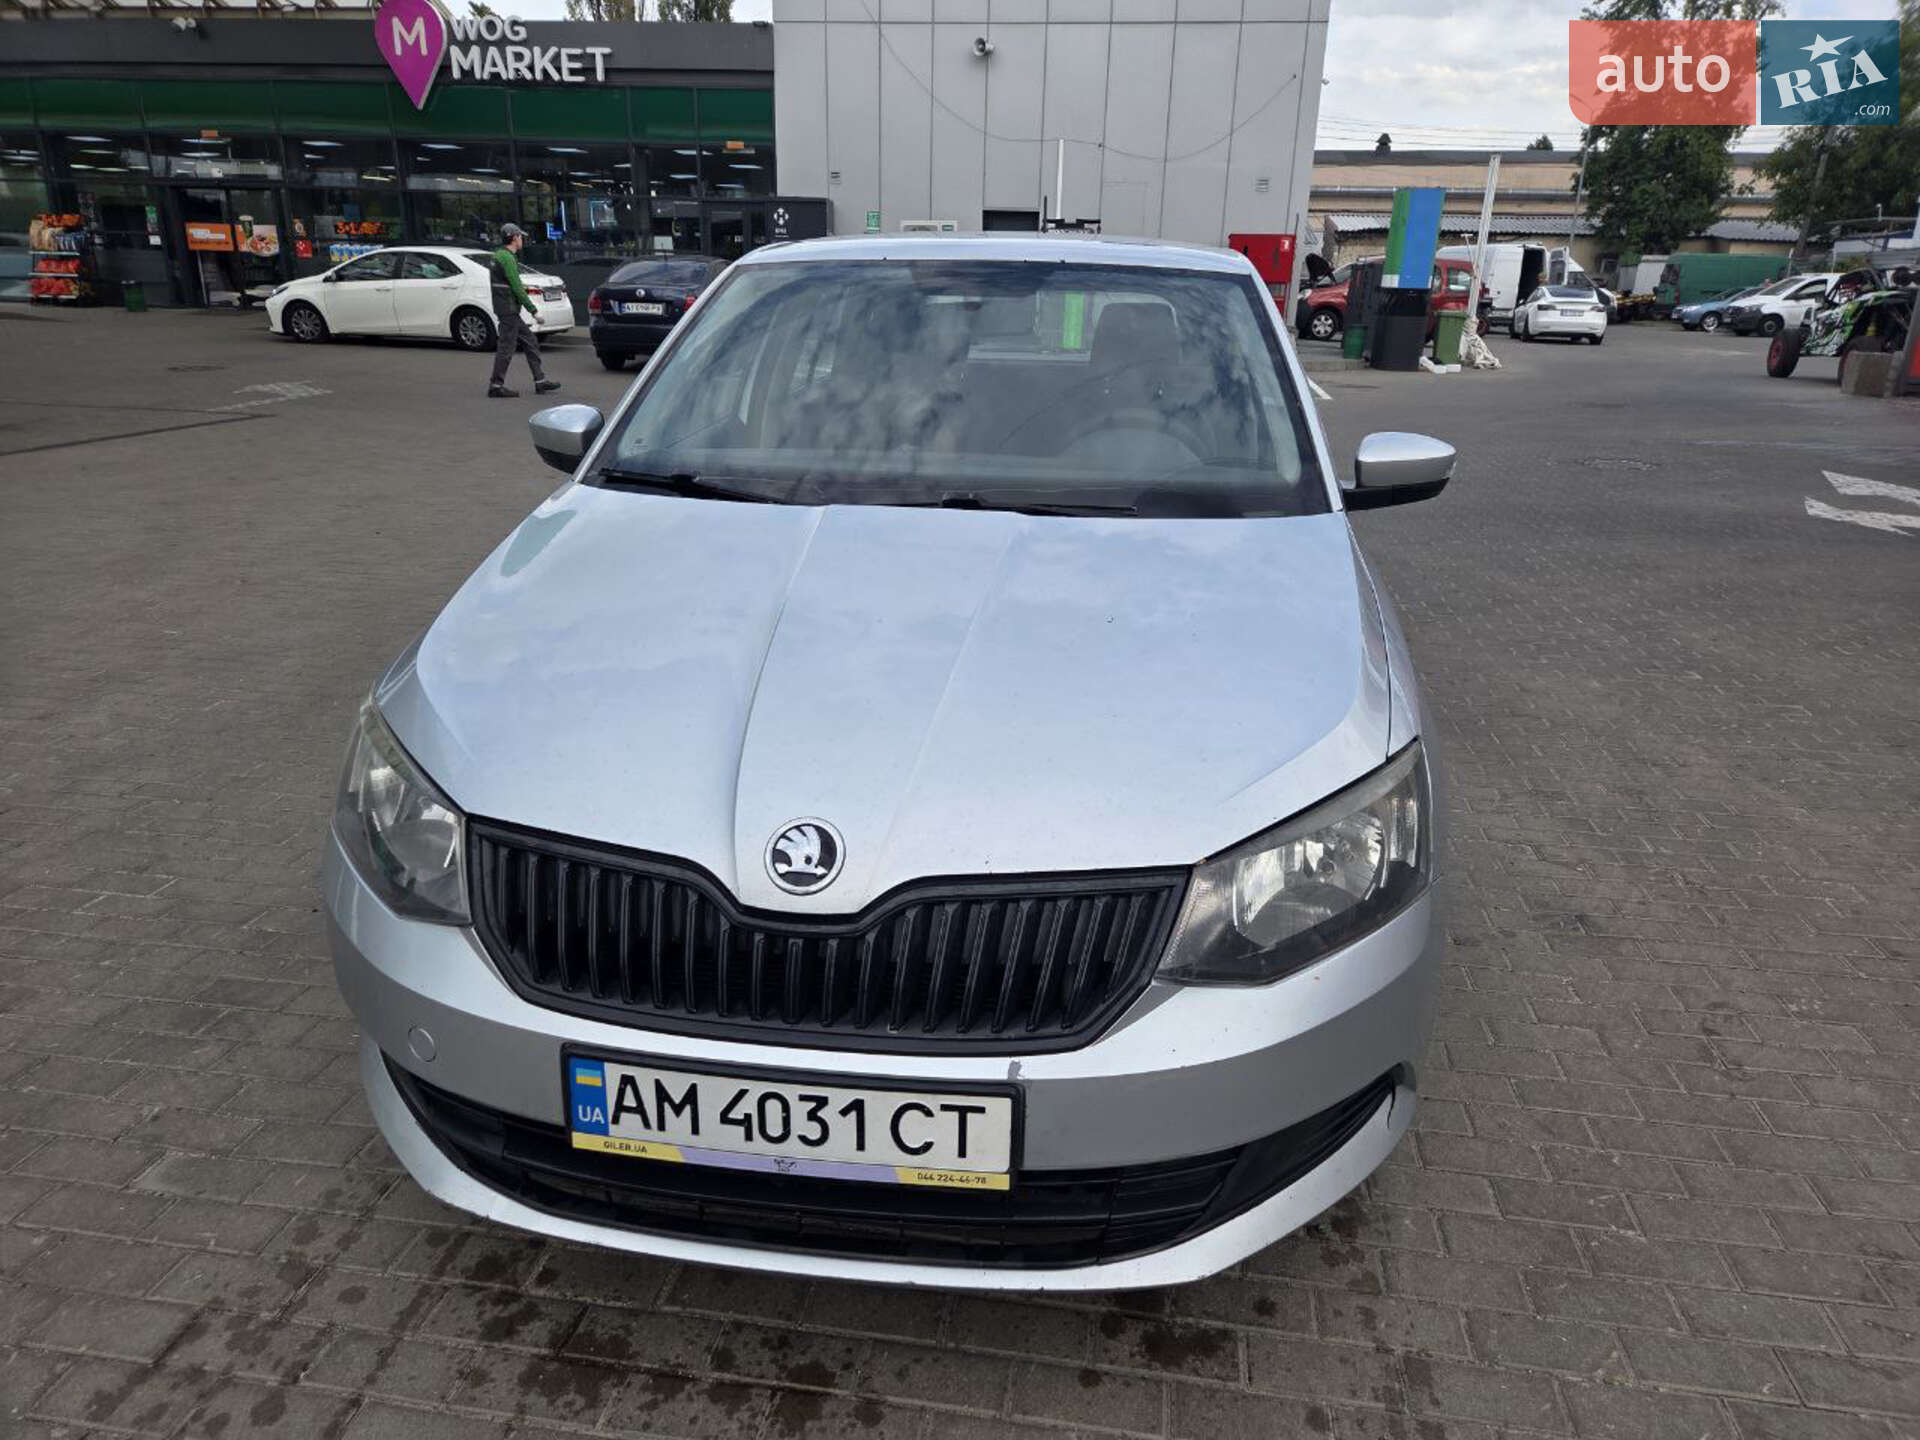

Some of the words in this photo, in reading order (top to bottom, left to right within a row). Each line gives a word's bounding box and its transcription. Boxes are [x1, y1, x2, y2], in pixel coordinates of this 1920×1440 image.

[391, 16, 428, 56] M
[450, 15, 528, 42] WOG
[449, 44, 613, 82] MARKET
[578, 1104, 605, 1124] UA
[610, 1073, 700, 1136] AM
[719, 1088, 866, 1152] 4031
[889, 1102, 986, 1159] CT
